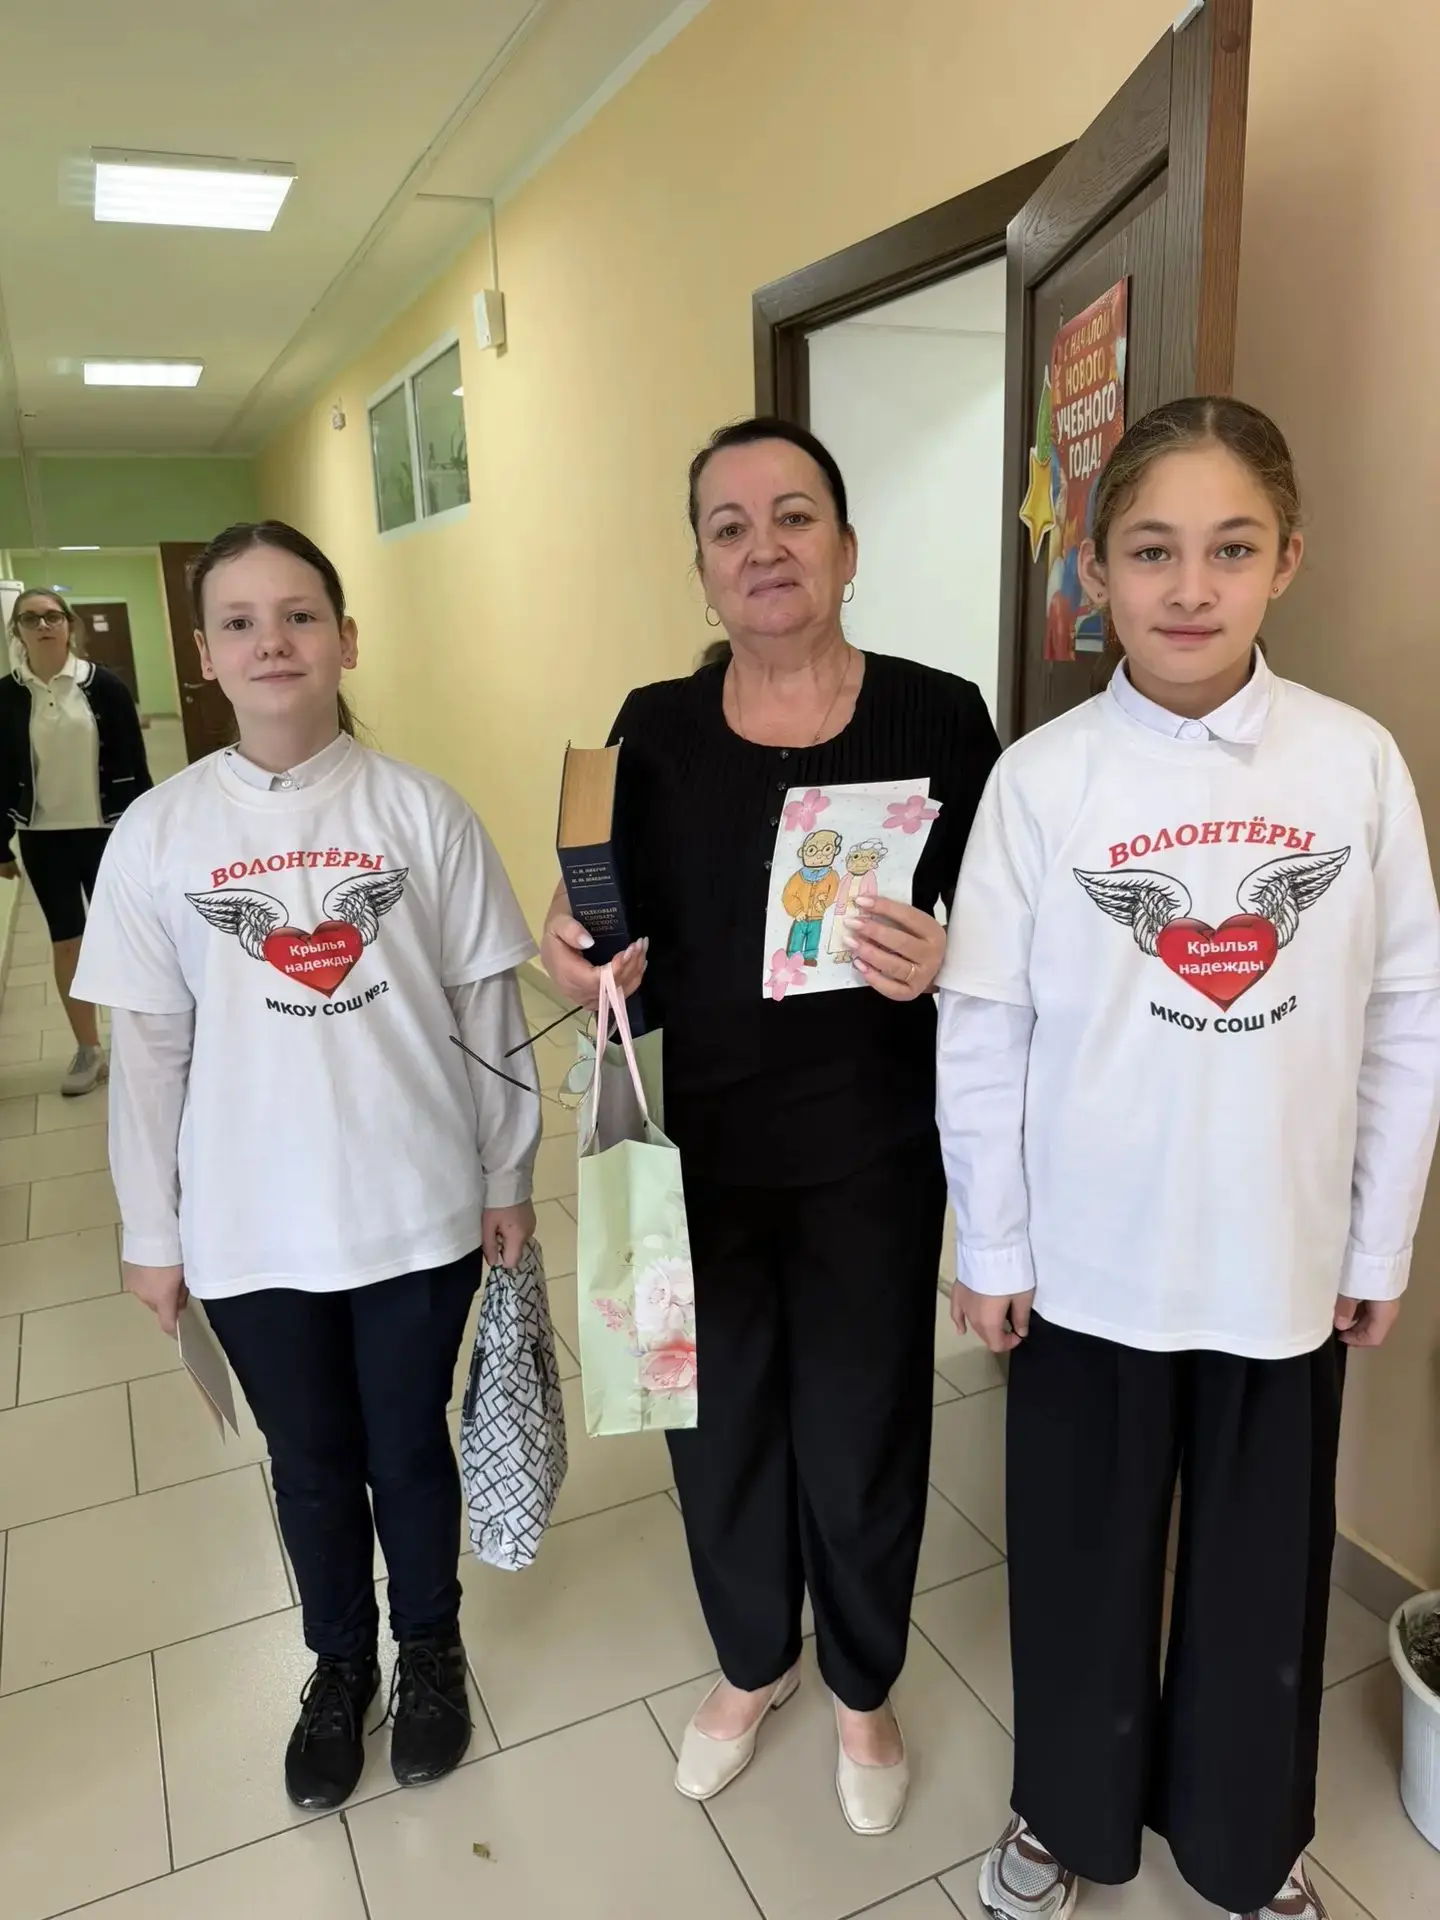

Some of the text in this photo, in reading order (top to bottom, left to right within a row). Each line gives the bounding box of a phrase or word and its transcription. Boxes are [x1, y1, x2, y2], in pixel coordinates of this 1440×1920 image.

[1063, 310, 1111, 362] С НАЧАЛОМ
[1065, 347, 1106, 397] НОВОГО
[1057, 380, 1117, 444] УЧЕБНОГО
[1069, 432, 1103, 481] ГОДА!
[1108, 816, 1316, 868] ВОЛОНТЁРЫ
[210, 847, 385, 888] ВОЛОНТЁРЫ
[284, 954, 354, 974] надежды
[289, 939, 346, 958] Крылья
[1187, 940, 1259, 957] Крылья
[1179, 959, 1265, 976] надежды
[265, 997, 317, 1017] МКОУ
[322, 995, 364, 1016] СОШ
[1150, 1001, 1208, 1032] МКОУ
[1213, 1013, 1265, 1033] СОШ
